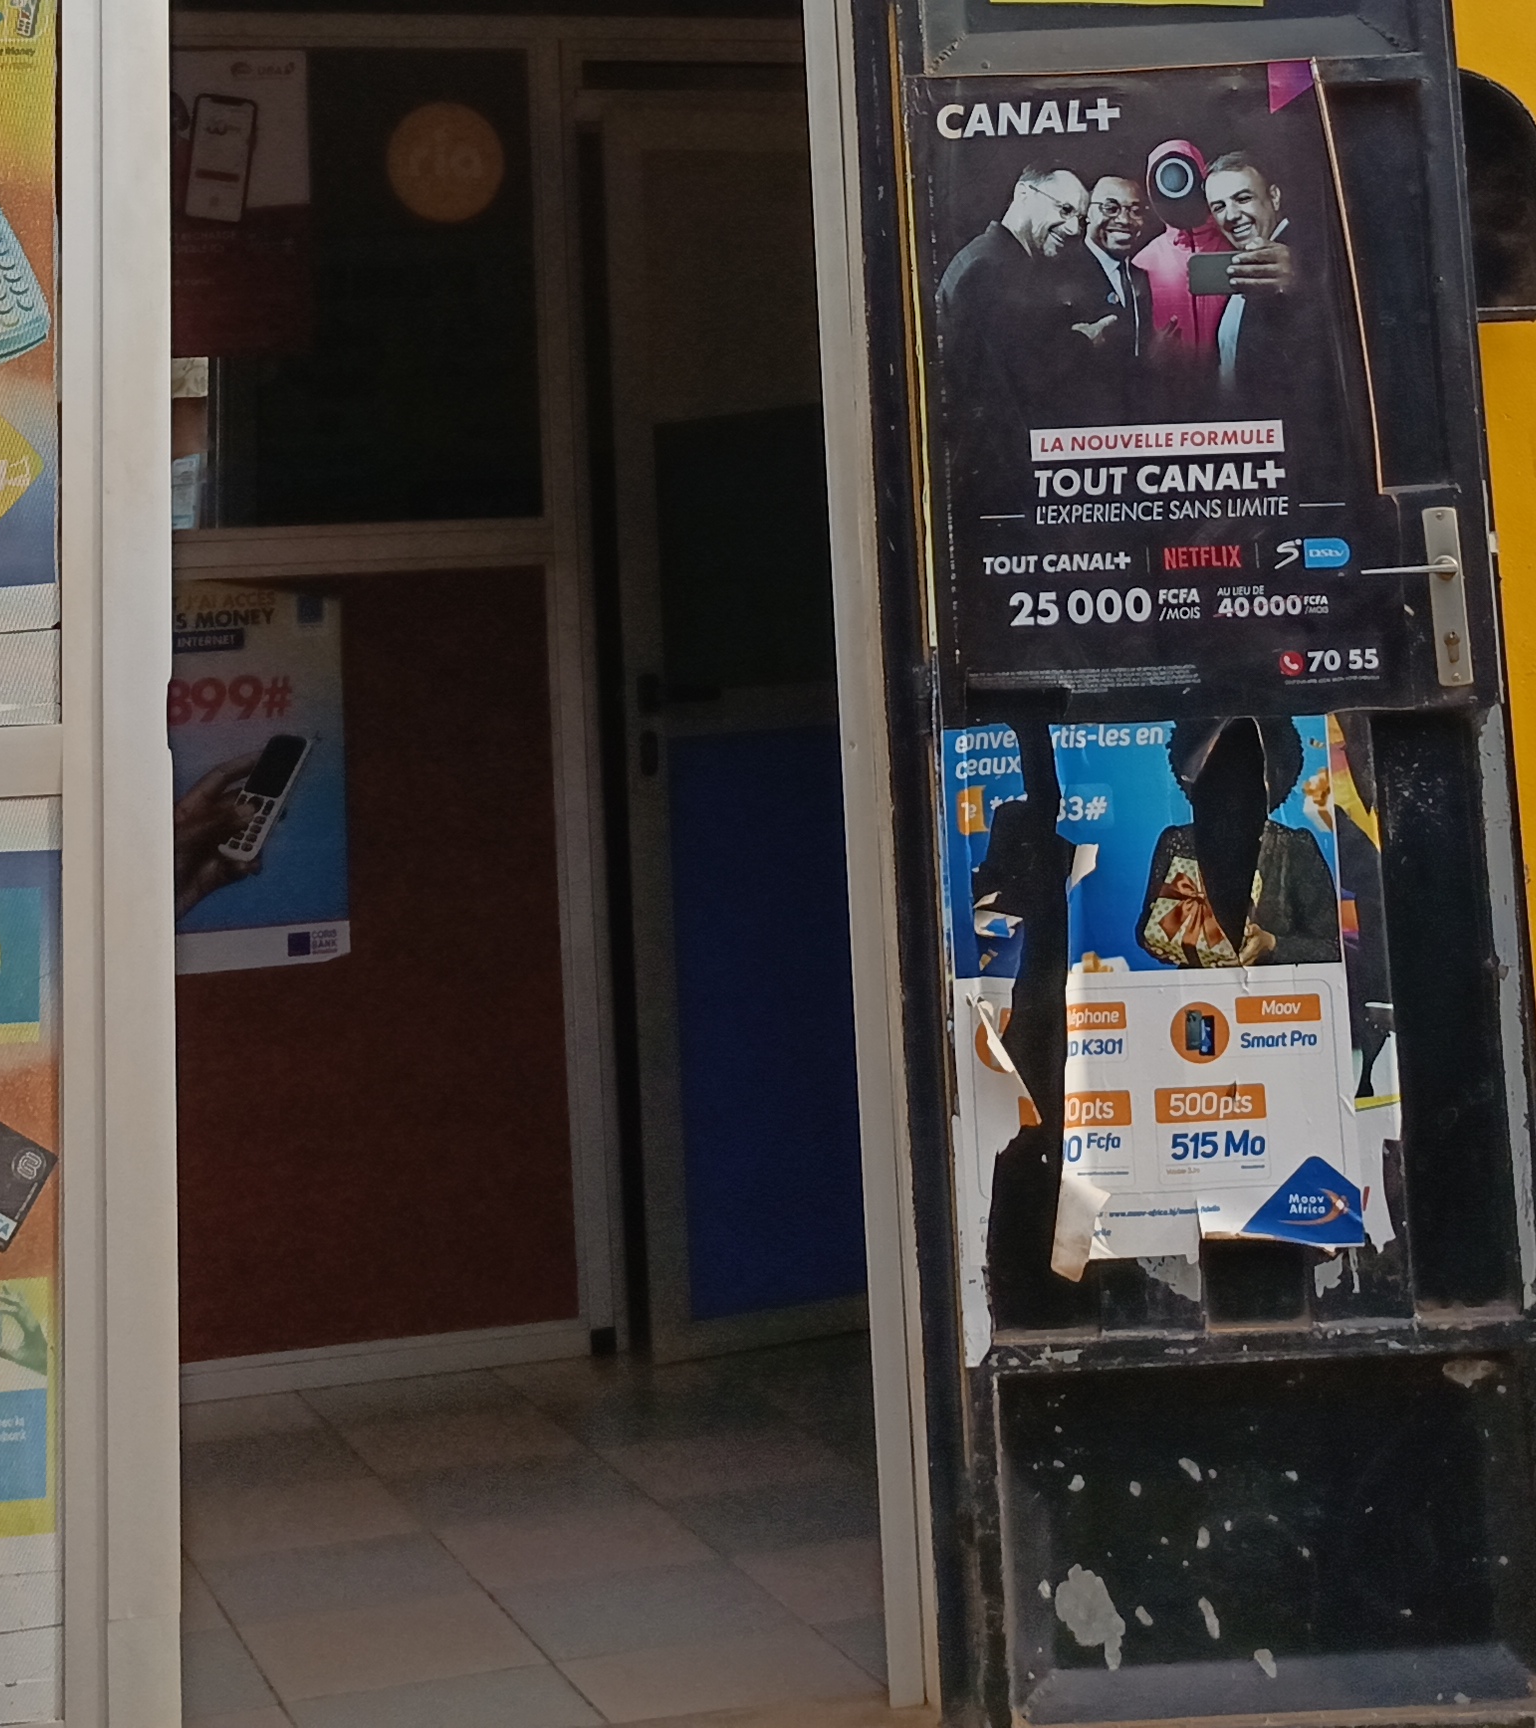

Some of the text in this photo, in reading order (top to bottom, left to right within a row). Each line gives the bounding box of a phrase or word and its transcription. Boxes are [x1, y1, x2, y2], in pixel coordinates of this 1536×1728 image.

[937, 98, 1120, 140] CANAL+
[1040, 427, 1276, 454] LA NOUVELLE FORMULE
[1034, 460, 1286, 498] TOUT CANAL+
[1169, 498, 1222, 519] SANS
[1227, 495, 1289, 518] LIMITE
[982, 551, 1131, 575] TOUT CANAL+
[1163, 545, 1242, 570] NETFLIX
[1157, 588, 1201, 606] FCFA
[1217, 584, 1265, 596] AU LIEU DE
[1009, 586, 1153, 628] 25 000
[1216, 597, 1249, 619] 40
[1303, 595, 1329, 606] FCFA
[196, 608, 275, 628] MONEY
[1158, 605, 1201, 622] /MOIS
[177, 634, 236, 648] INTERNET
[1307, 648, 1379, 672] 70 55
[1136, 727, 1163, 746] en
[312, 938, 337, 950] BANK
[1261, 1000, 1301, 1016] Moov
[1081, 1038, 1123, 1056] K301
[1240, 1030, 1317, 1049] Smart Pro
[1169, 1092, 1252, 1120] 500pts
[1086, 1132, 1121, 1152] Fcfa
[1170, 1130, 1265, 1160] 515 Mo
[1288, 1192, 1324, 1205] Moov
[1289, 1204, 1325, 1215] Africa
